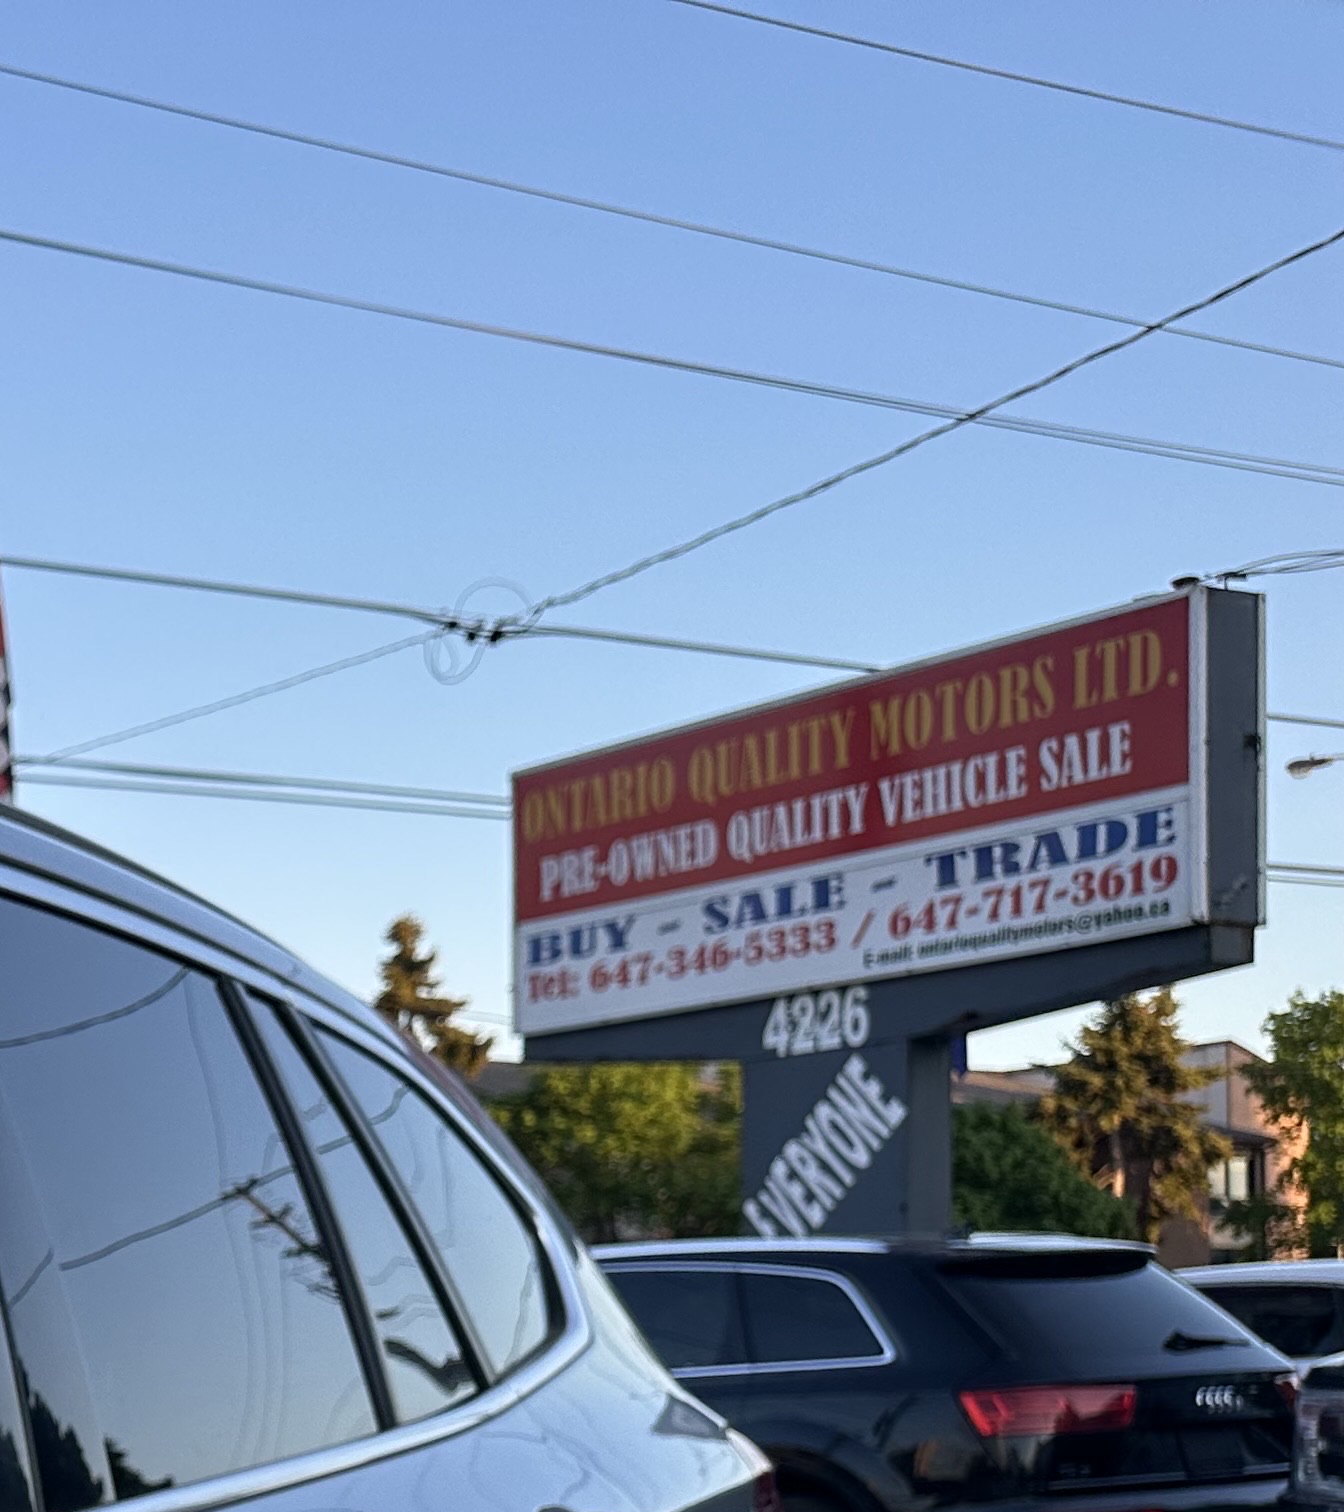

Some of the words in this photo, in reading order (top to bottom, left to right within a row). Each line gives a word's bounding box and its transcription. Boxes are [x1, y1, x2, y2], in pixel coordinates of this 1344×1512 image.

[524, 759, 674, 840] ONTARIO
[690, 709, 854, 804] QUALITY
[871, 657, 1053, 759] MOTORS
[1074, 630, 1177, 709] LTD.
[540, 819, 718, 900] PRE-OWNED
[728, 786, 867, 862] QUALITY
[880, 746, 1026, 826] VEHICLE
[1041, 722, 1130, 791] SALE
[528, 915, 636, 966] BUY
[704, 874, 844, 934] SALE
[926, 808, 1176, 890] TRADE
[529, 972, 577, 1001] Tel:
[590, 920, 835, 992] 647-346-5333
[889, 856, 1177, 939] 647-717-3619
[764, 987, 869, 1057] 4226
